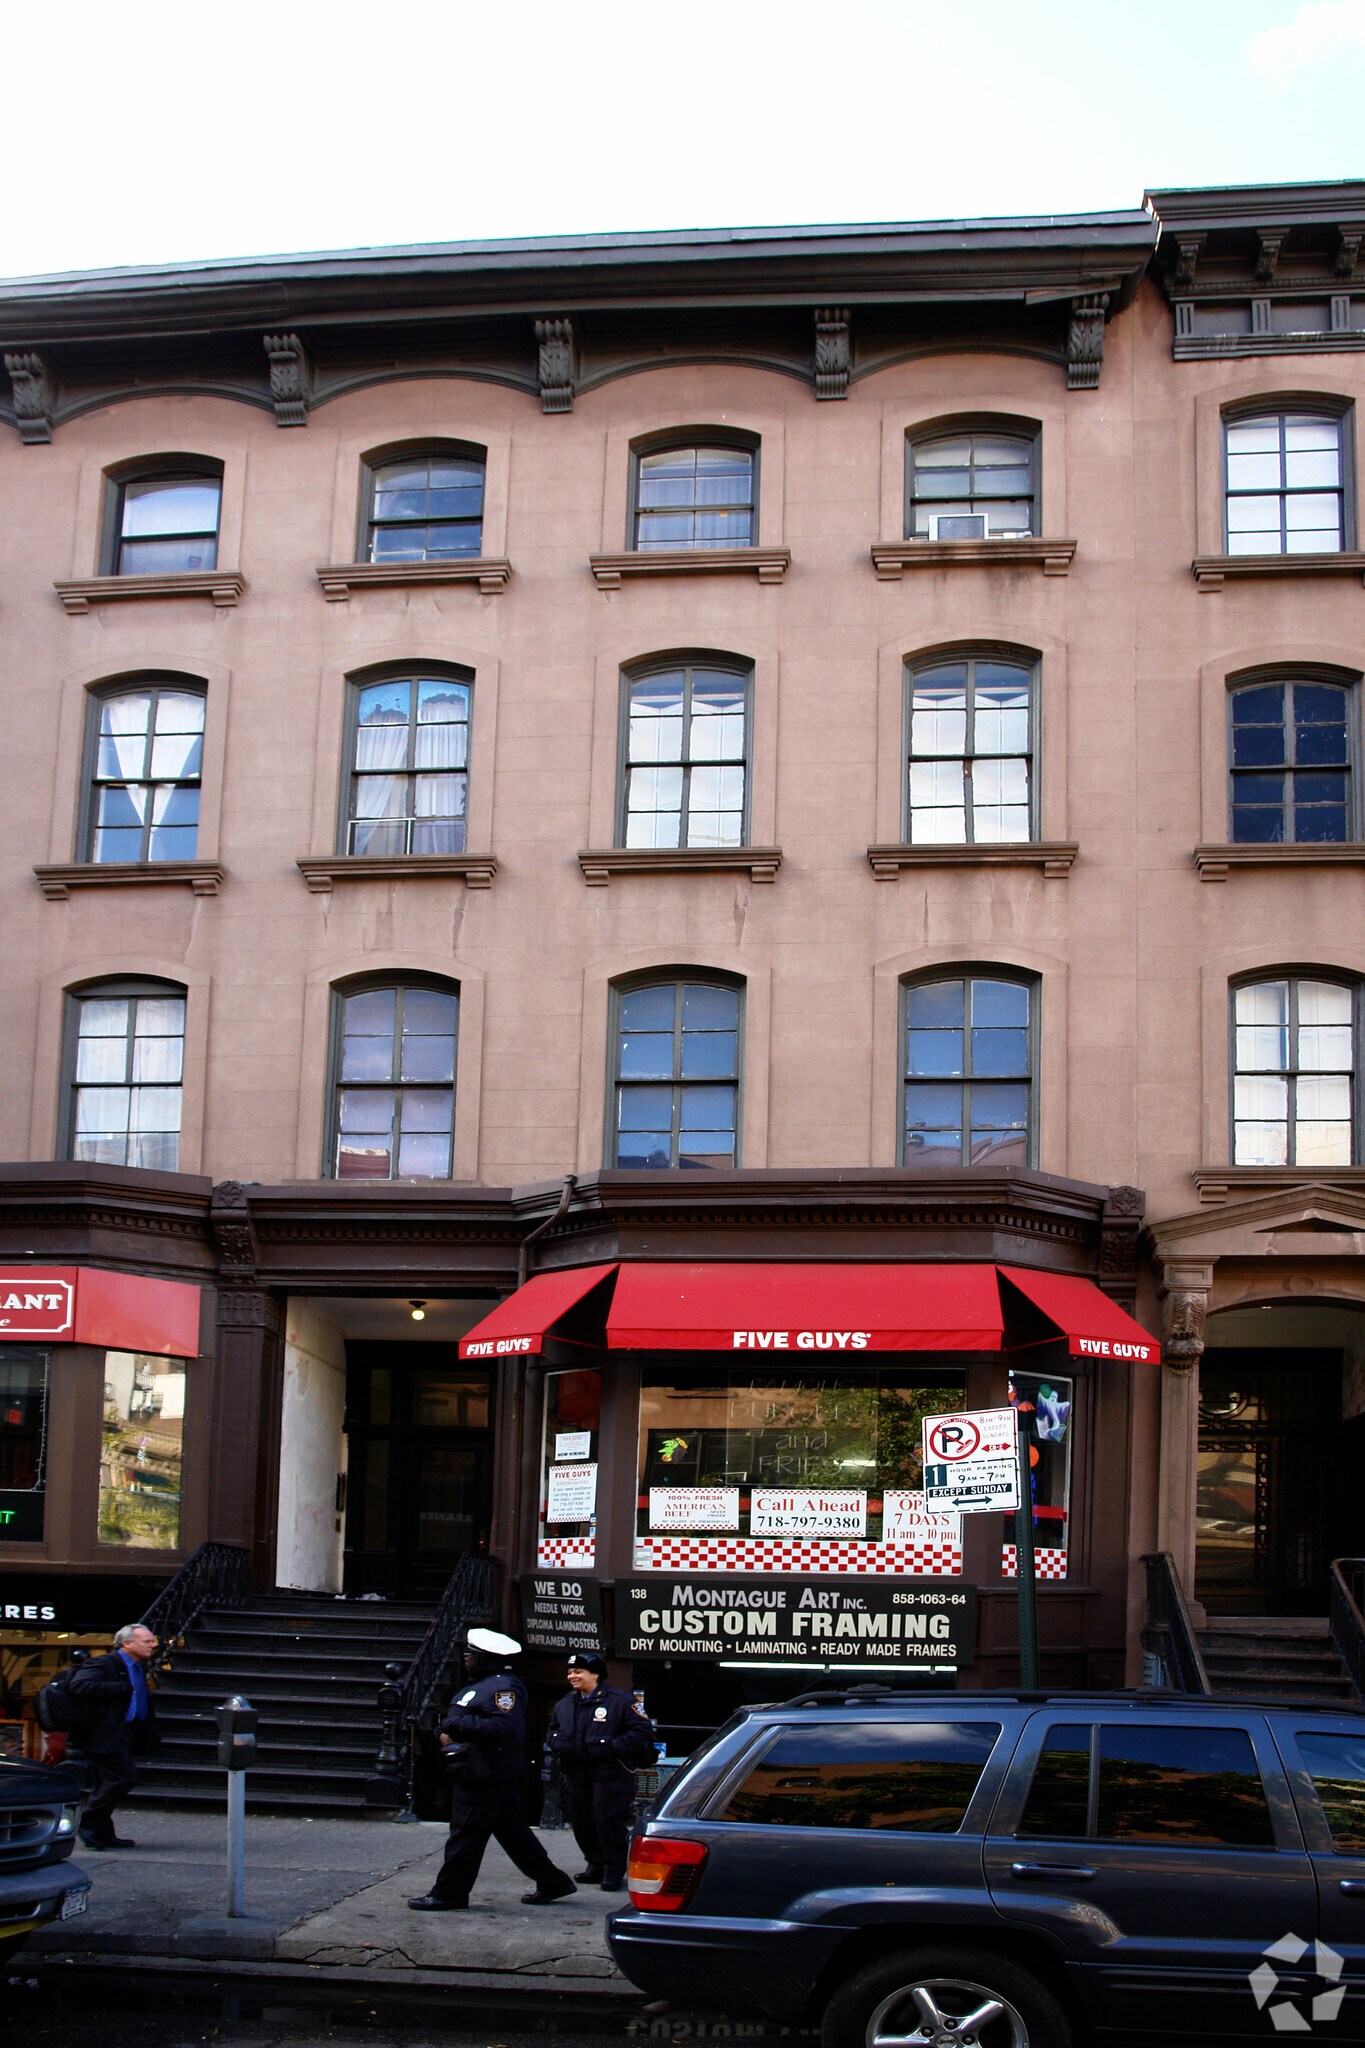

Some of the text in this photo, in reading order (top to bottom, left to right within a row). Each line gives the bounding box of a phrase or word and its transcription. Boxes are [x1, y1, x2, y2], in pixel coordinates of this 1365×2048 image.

[0, 1293, 63, 1310] ANT
[466, 1337, 532, 1356] FIVE GUYS
[733, 1331, 872, 1349] FIVE GUYS
[1079, 1339, 1150, 1360] FIVE GUYS
[775, 1431, 828, 1450] and
[933, 1467, 939, 1486] 1
[933, 1484, 1008, 1497] EXCEPT SUNDAY
[664, 1503, 726, 1511] AMERICAN
[757, 1497, 861, 1513] Call Ahead
[899, 1498, 925, 1511] OP
[757, 1515, 861, 1530] 718-797-9380
[895, 1513, 950, 1526] 7 DAYS
[887, 1528, 896, 1539] 11
[900, 1530, 916, 1539] am
[928, 1529, 937, 1539] 10
[940, 1531, 957, 1543] pm
[534, 1581, 583, 1597] WE DO
[631, 1585, 966, 1610] 138 MONTAGUE ART INC. 858-1063-64
[0, 1605, 56, 1620] RES
[534, 1602, 586, 1616] NEEDLE WORK
[527, 1618, 598, 1634] DIPLOMA LAMINATIONS
[639, 1609, 950, 1639] CUSTOM FRAMING
[527, 1634, 600, 1650] UNFRAMED POSTERS
[630, 1639, 957, 1657] DRY MOUNTING LAMINATING READY MADE FRAMES
